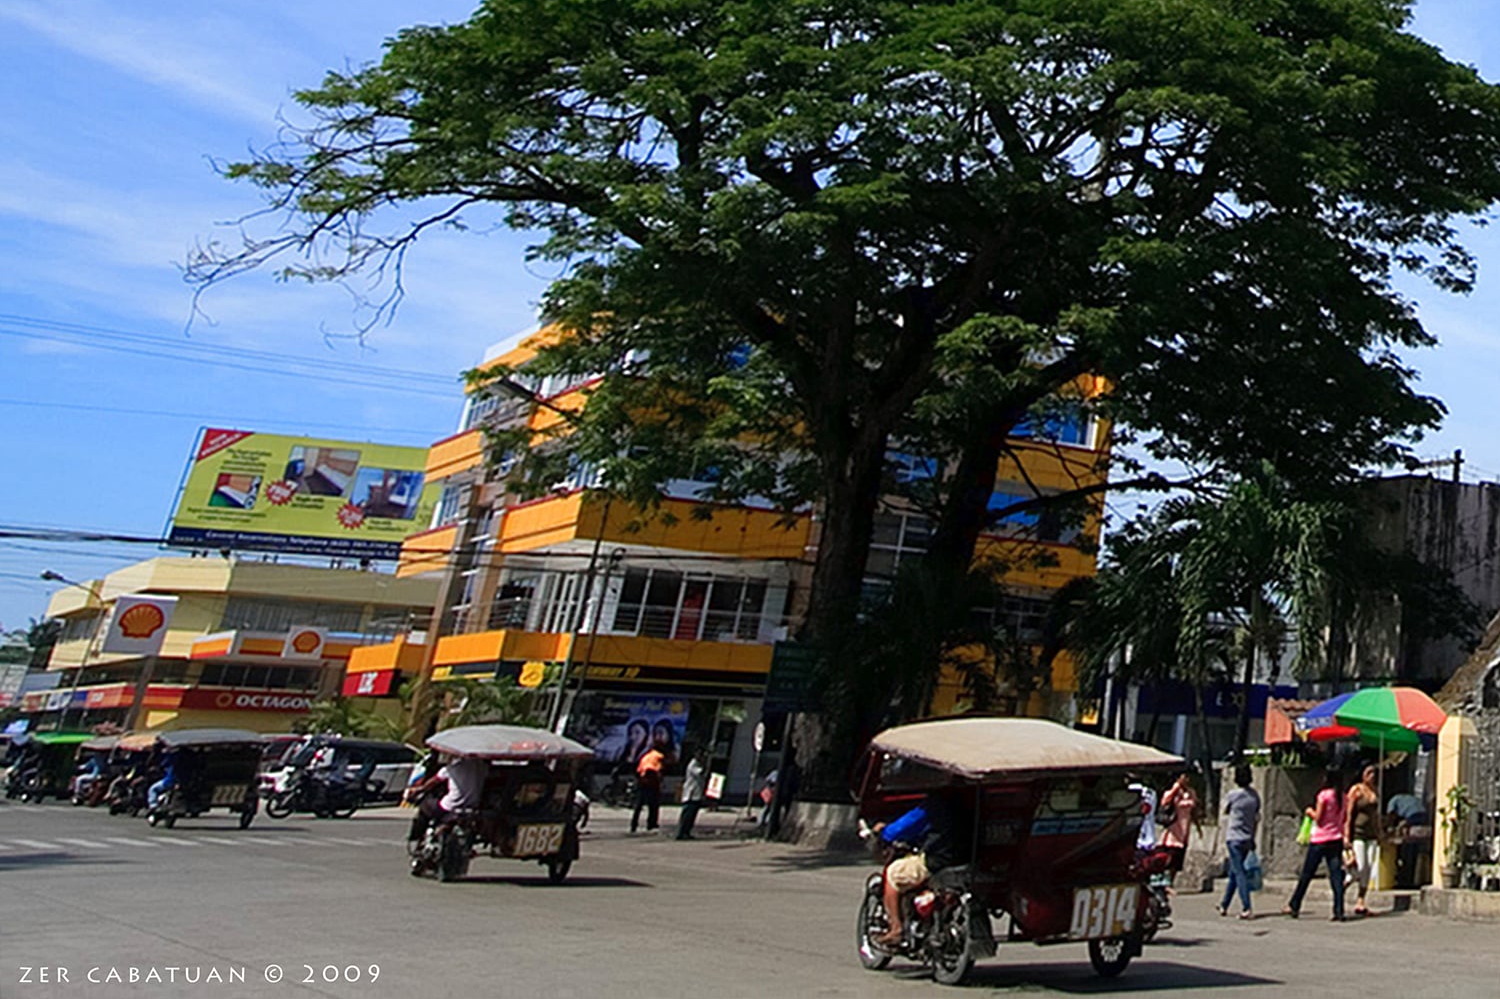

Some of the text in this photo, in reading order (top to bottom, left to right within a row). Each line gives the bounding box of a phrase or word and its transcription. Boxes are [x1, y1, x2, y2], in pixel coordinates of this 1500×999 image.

[236, 693, 313, 709] OCTAGON
[513, 824, 564, 856] 1682
[1070, 886, 1137, 939] 0314
